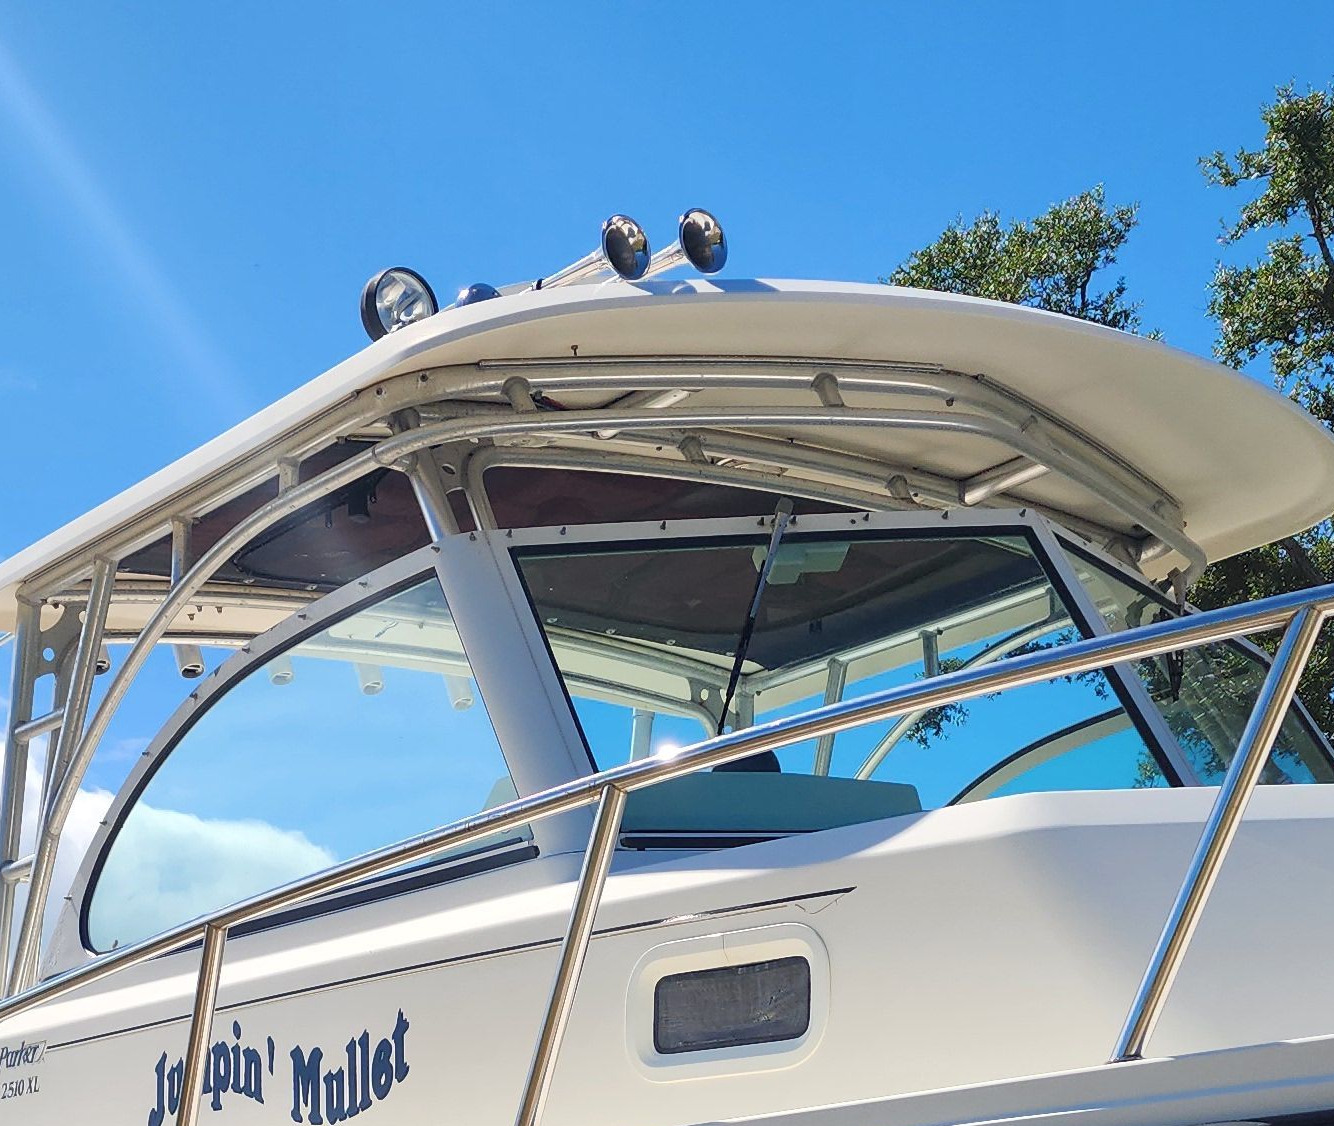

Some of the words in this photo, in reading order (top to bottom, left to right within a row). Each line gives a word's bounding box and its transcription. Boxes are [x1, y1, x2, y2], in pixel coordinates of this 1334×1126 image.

[1, 1079, 25, 1100] 2510
[26, 1076, 40, 1095] XL
[290, 1008, 410, 1126] Mullet
